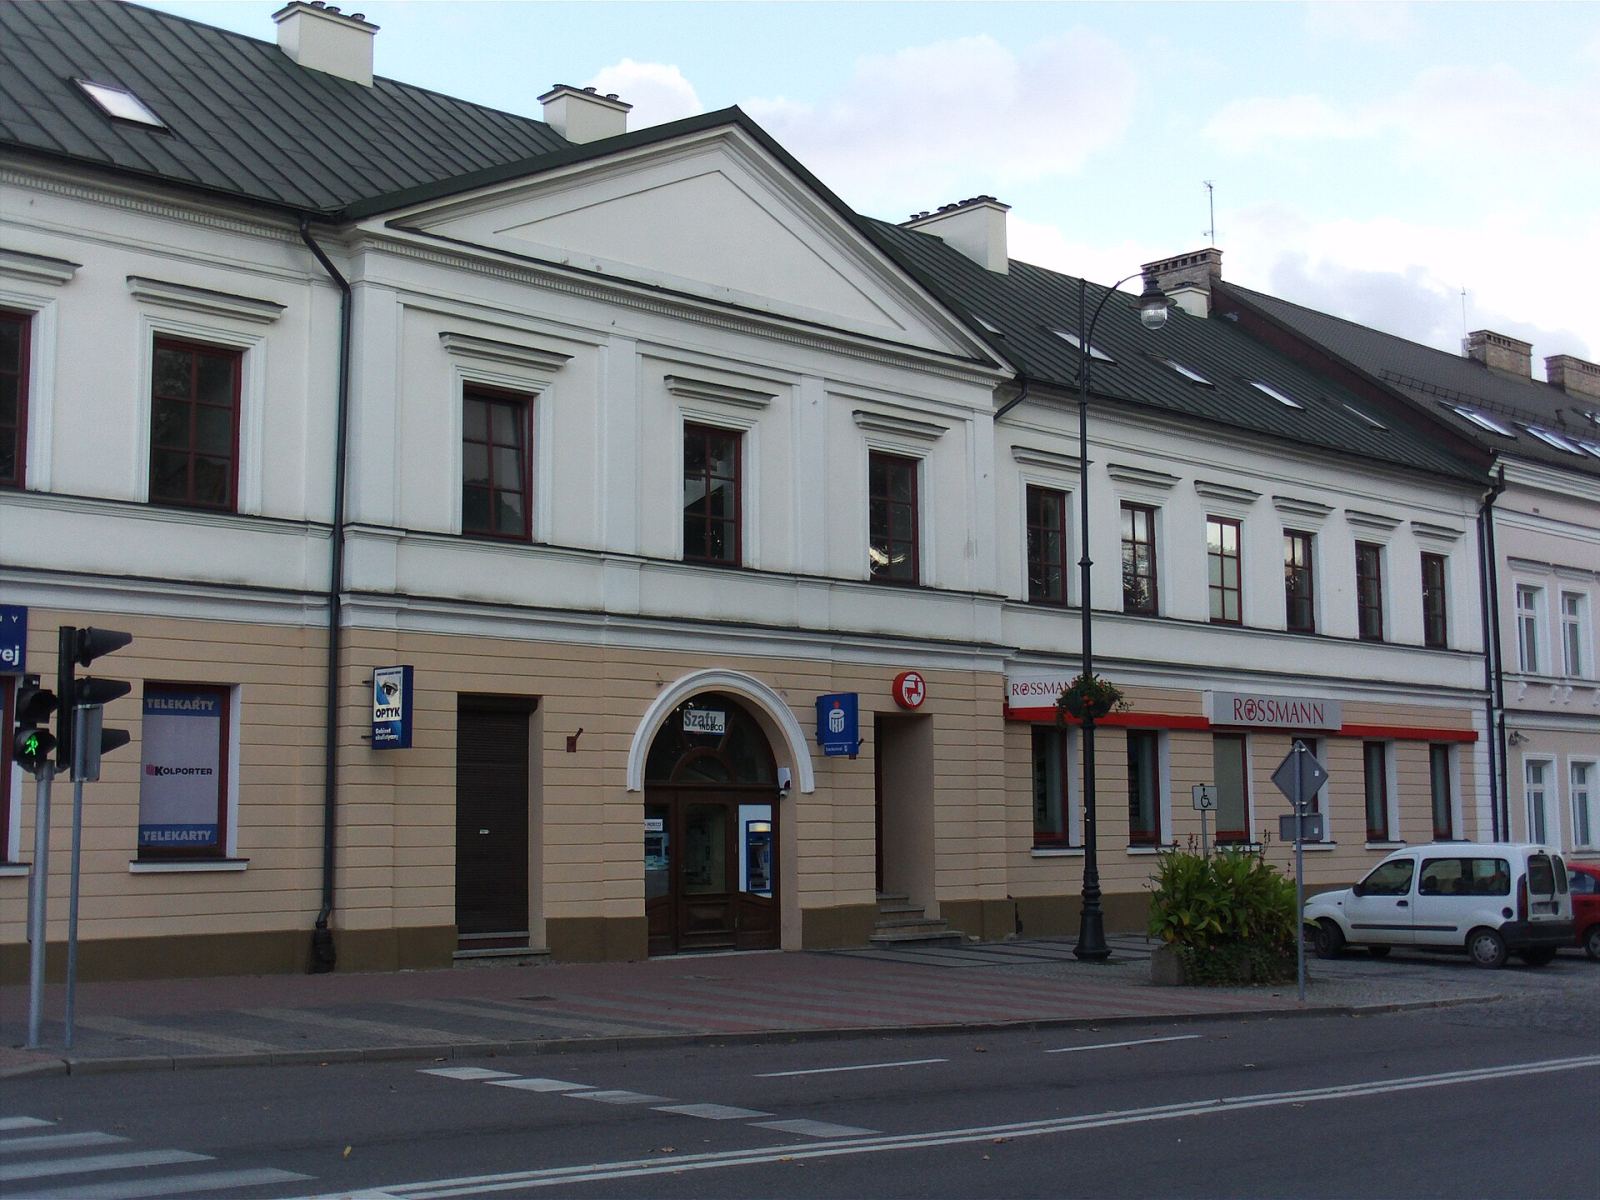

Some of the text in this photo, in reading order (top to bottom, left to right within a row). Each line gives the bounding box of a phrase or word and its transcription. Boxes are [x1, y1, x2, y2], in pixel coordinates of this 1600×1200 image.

[0, 645, 20, 666] ej
[1012, 681, 1073, 696] ROSSMAN
[147, 697, 215, 711] TELEKARTY
[375, 707, 401, 719] OPTYK
[1233, 698, 1325, 725] ROSSMANN
[699, 723, 724, 732] INDECO
[154, 765, 214, 777] KOLPORTER
[143, 830, 213, 842] TELEKARTY
